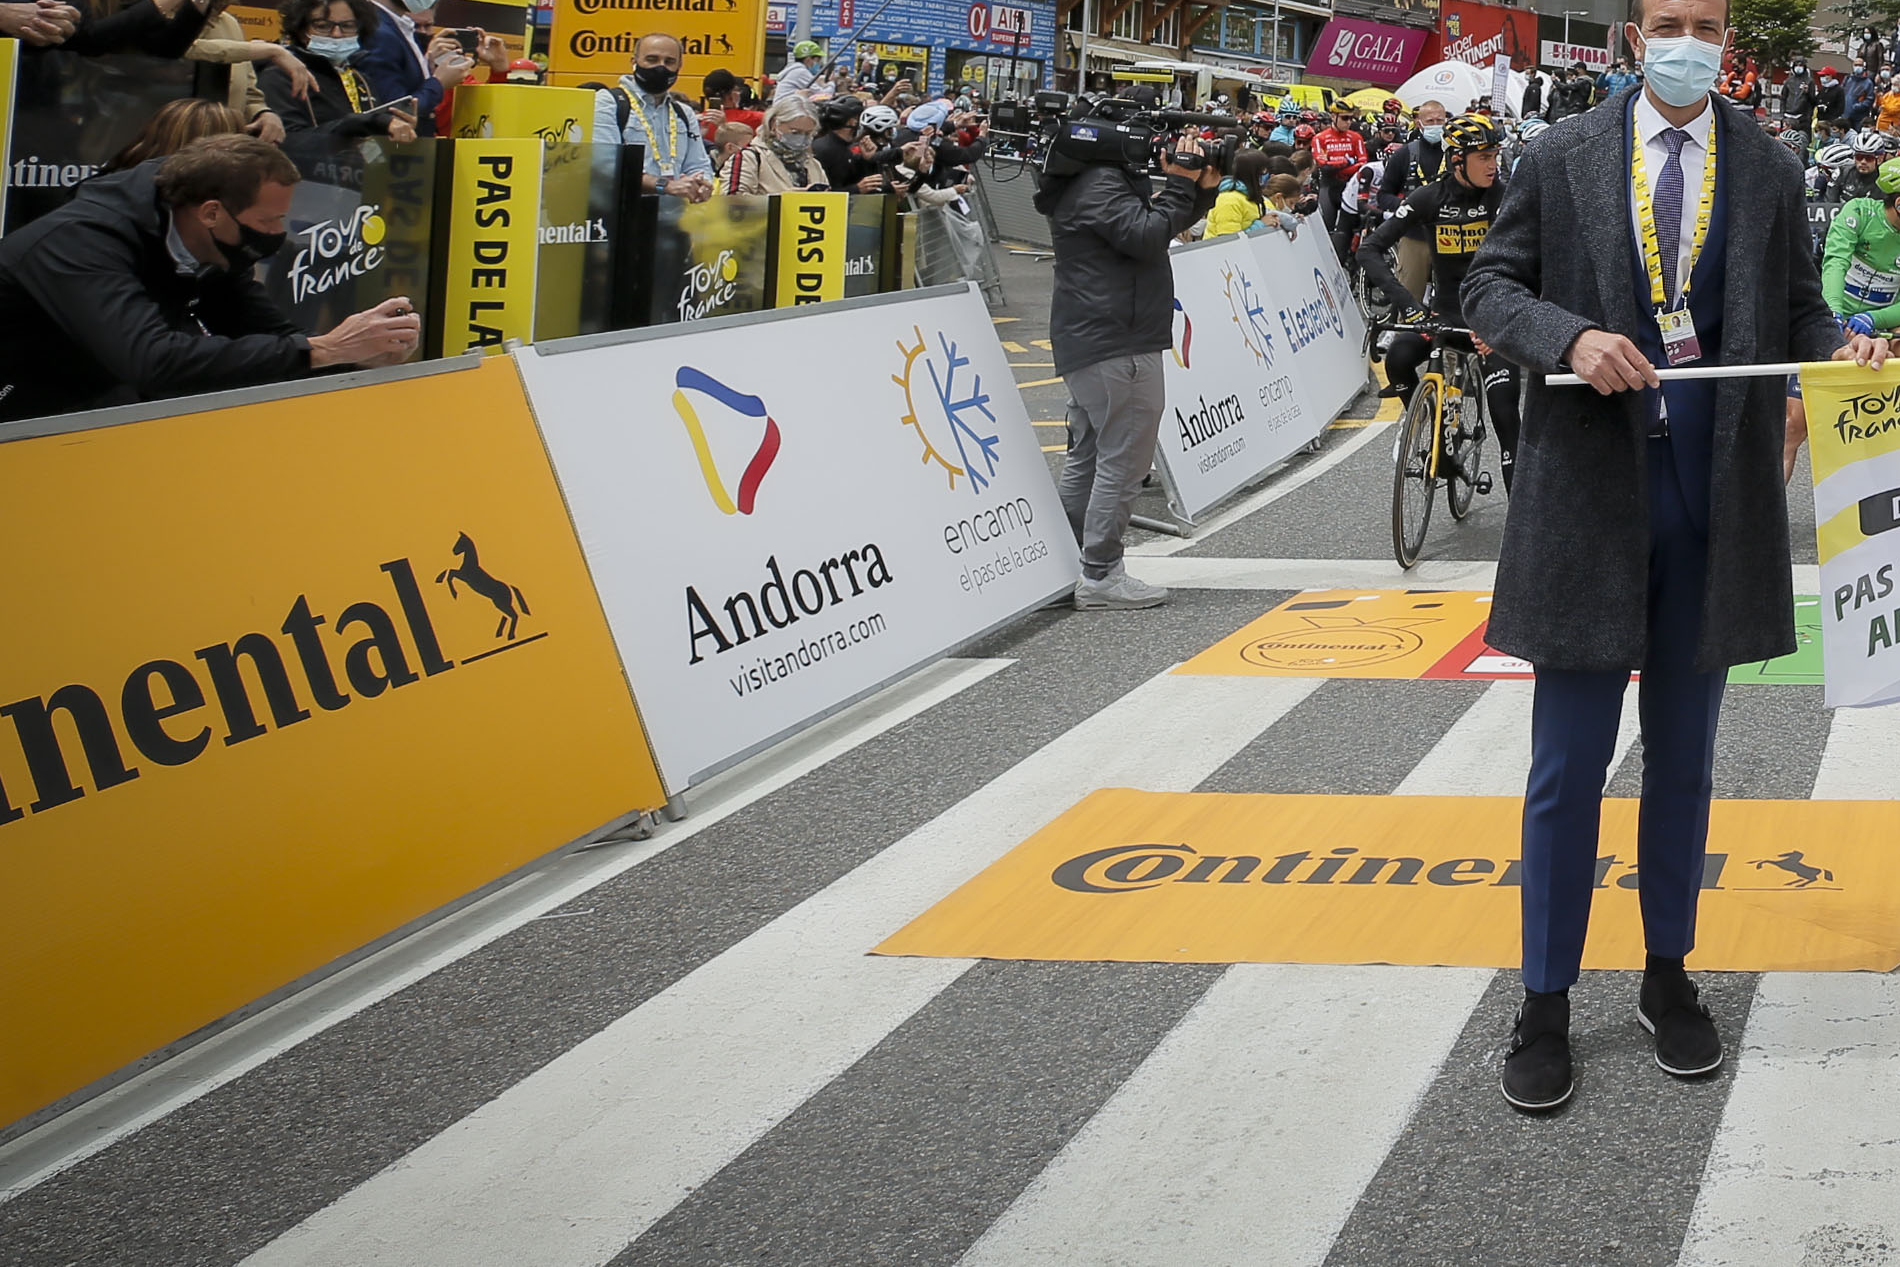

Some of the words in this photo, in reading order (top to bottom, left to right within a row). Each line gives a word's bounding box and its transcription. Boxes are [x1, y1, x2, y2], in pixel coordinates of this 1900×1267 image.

[569, 29, 712, 58] Contital
[1354, 33, 1405, 64] GALA
[1443, 33, 1473, 60] super
[474, 156, 513, 228] PAS
[1807, 207, 1826, 222] LA
[299, 204, 381, 265] TOUR
[796, 206, 826, 263] PAS
[1440, 226, 1488, 237] JUMBO
[1455, 238, 1481, 247] VISM
[471, 241, 509, 289] DE
[684, 250, 734, 296] TOUR
[466, 302, 506, 349] LA
[1258, 374, 1294, 408] encamp
[1174, 392, 1246, 453] Andorra
[1198, 436, 1247, 475] visitandorra.com
[943, 495, 1034, 555] encamp
[959, 566, 974, 593] el
[973, 561, 996, 595] pas
[996, 550, 1012, 576] de
[1012, 547, 1024, 570] la
[1021, 539, 1048, 568] casa
[686, 542, 893, 666] Andorra
[1833, 563, 1894, 622] PAS
[729, 611, 888, 698] visitandorra.com
